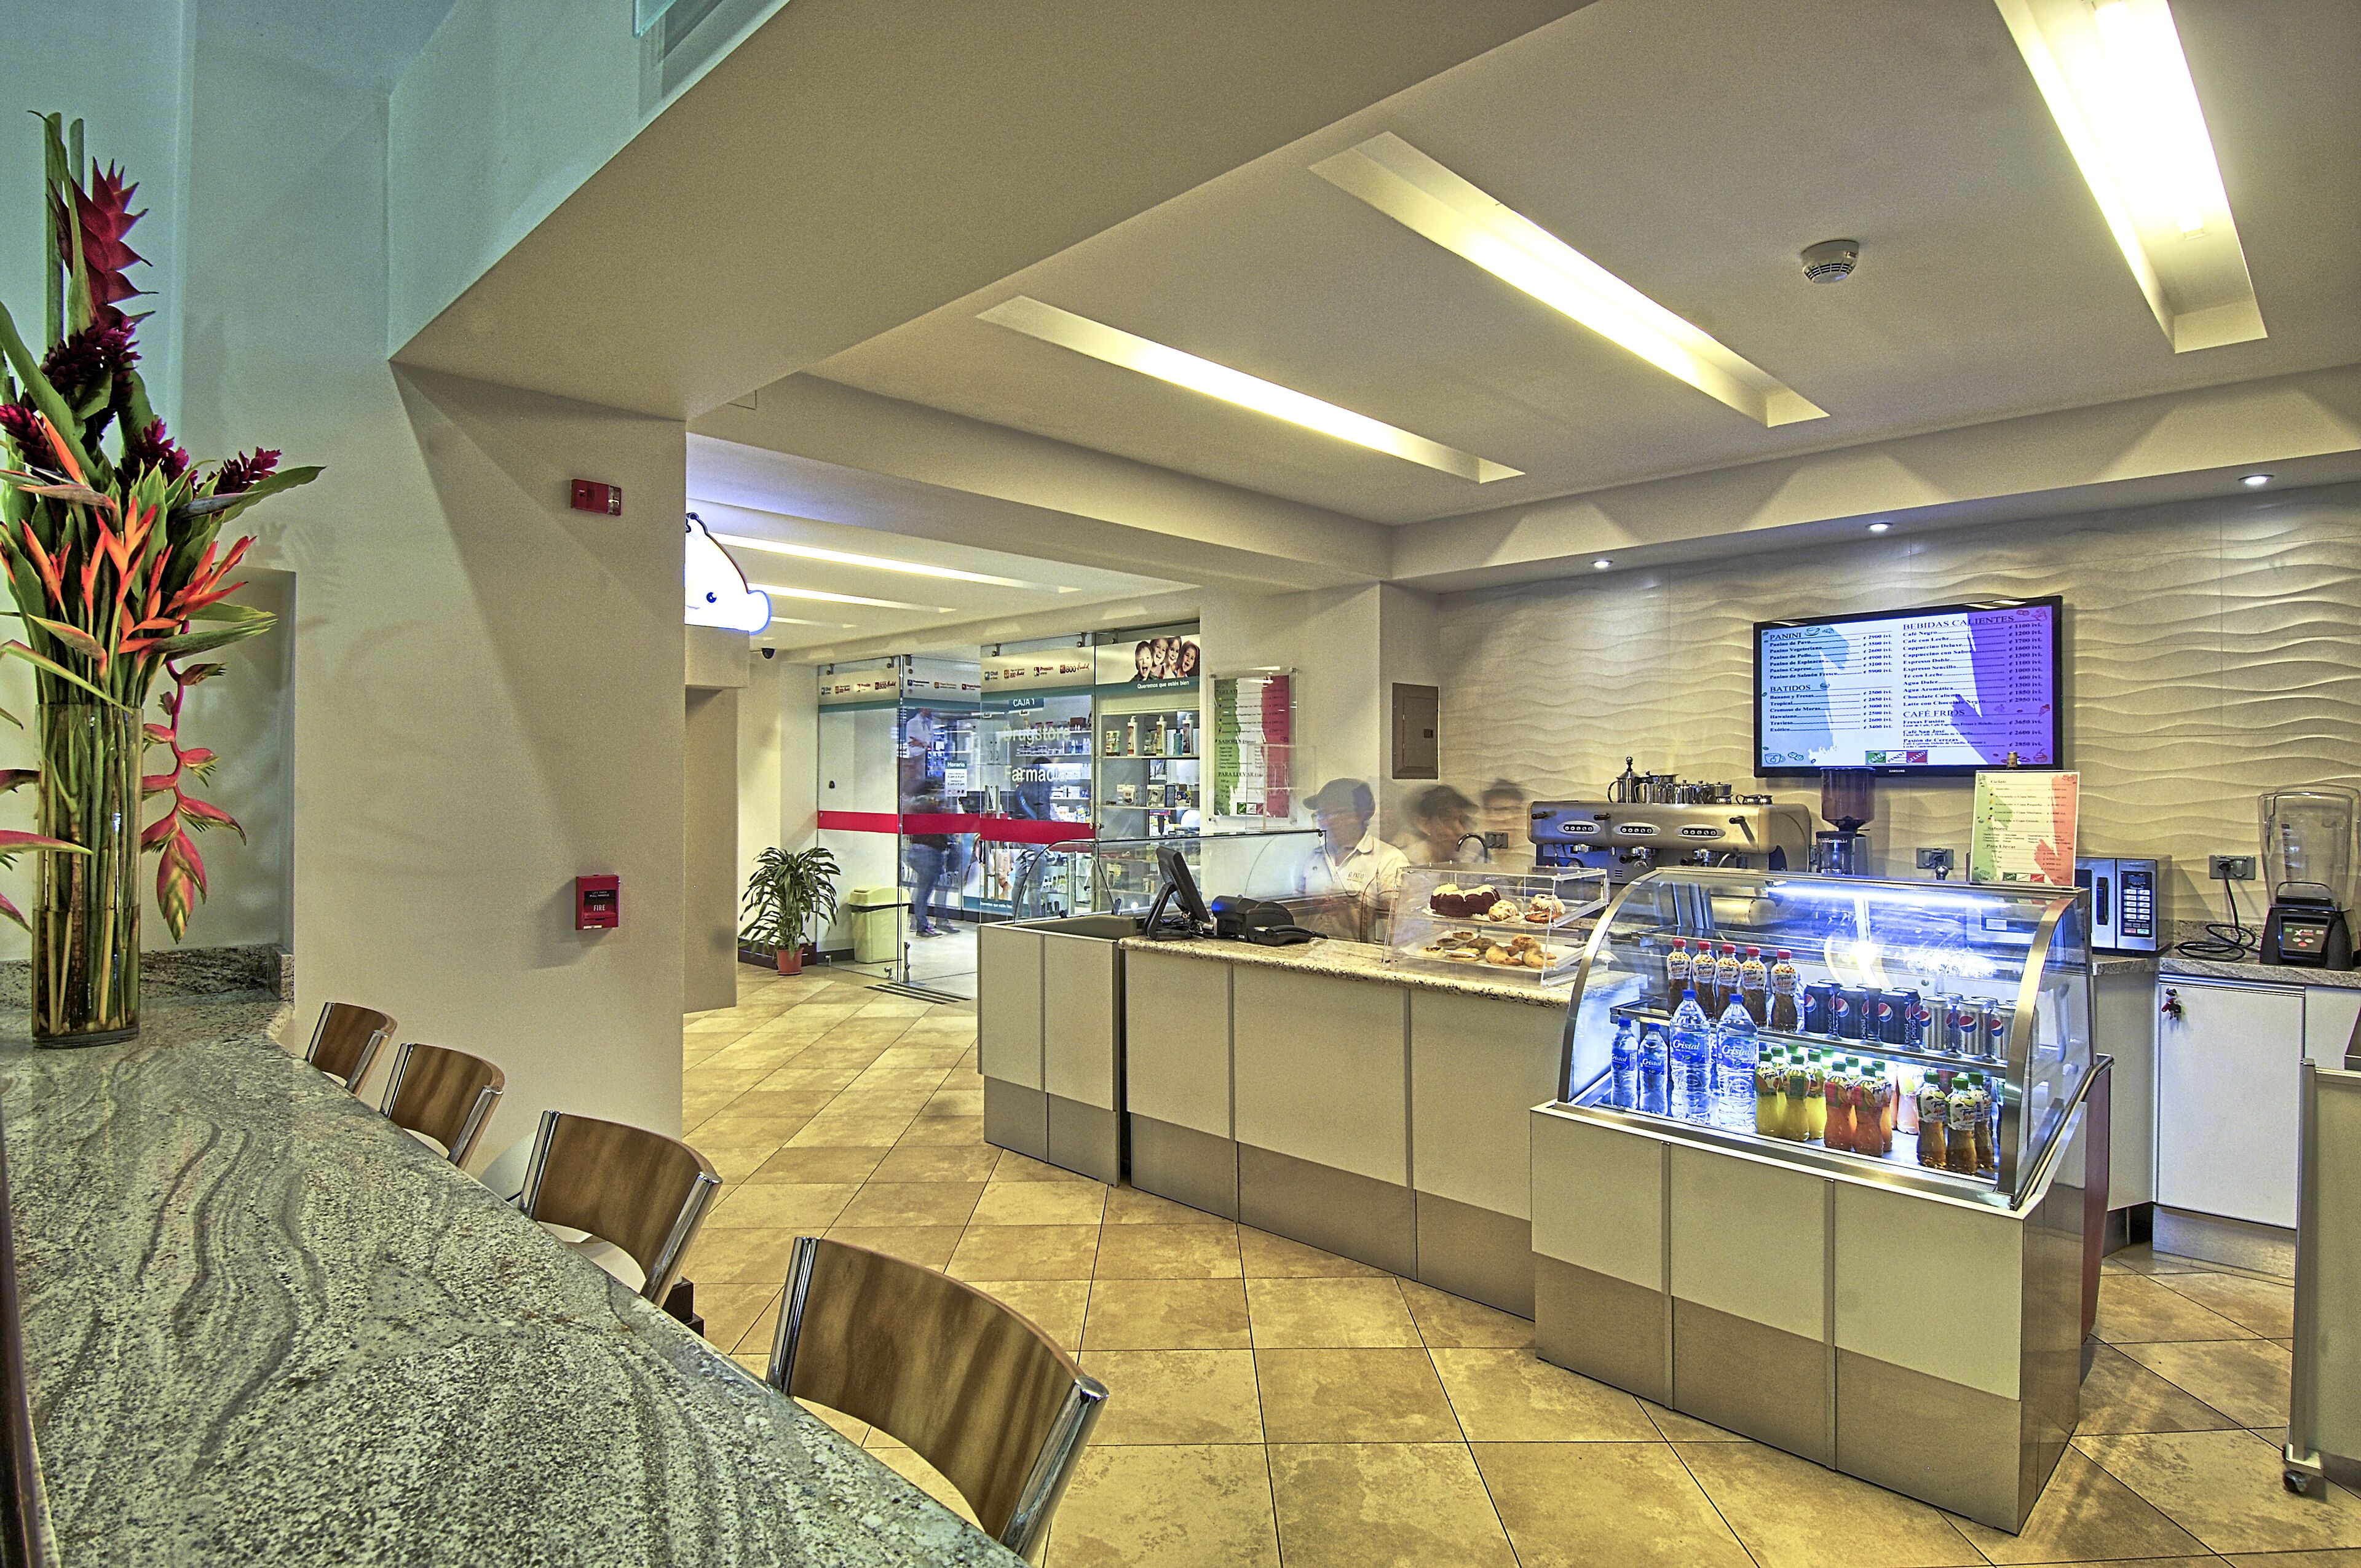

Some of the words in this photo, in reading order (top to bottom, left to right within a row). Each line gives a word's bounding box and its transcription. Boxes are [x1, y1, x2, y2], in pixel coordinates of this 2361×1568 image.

[1904, 621, 1948, 630] BEBIDAS
[1953, 616, 2014, 626] CALIENTES
[1904, 709, 1931, 718] CAFÉ
[1003, 725, 1070, 745] Drugstore
[1003, 765, 1067, 782] Farmacia
[1673, 1040, 1700, 1050] Cristal
[1722, 1045, 1750, 1056] Cristal
